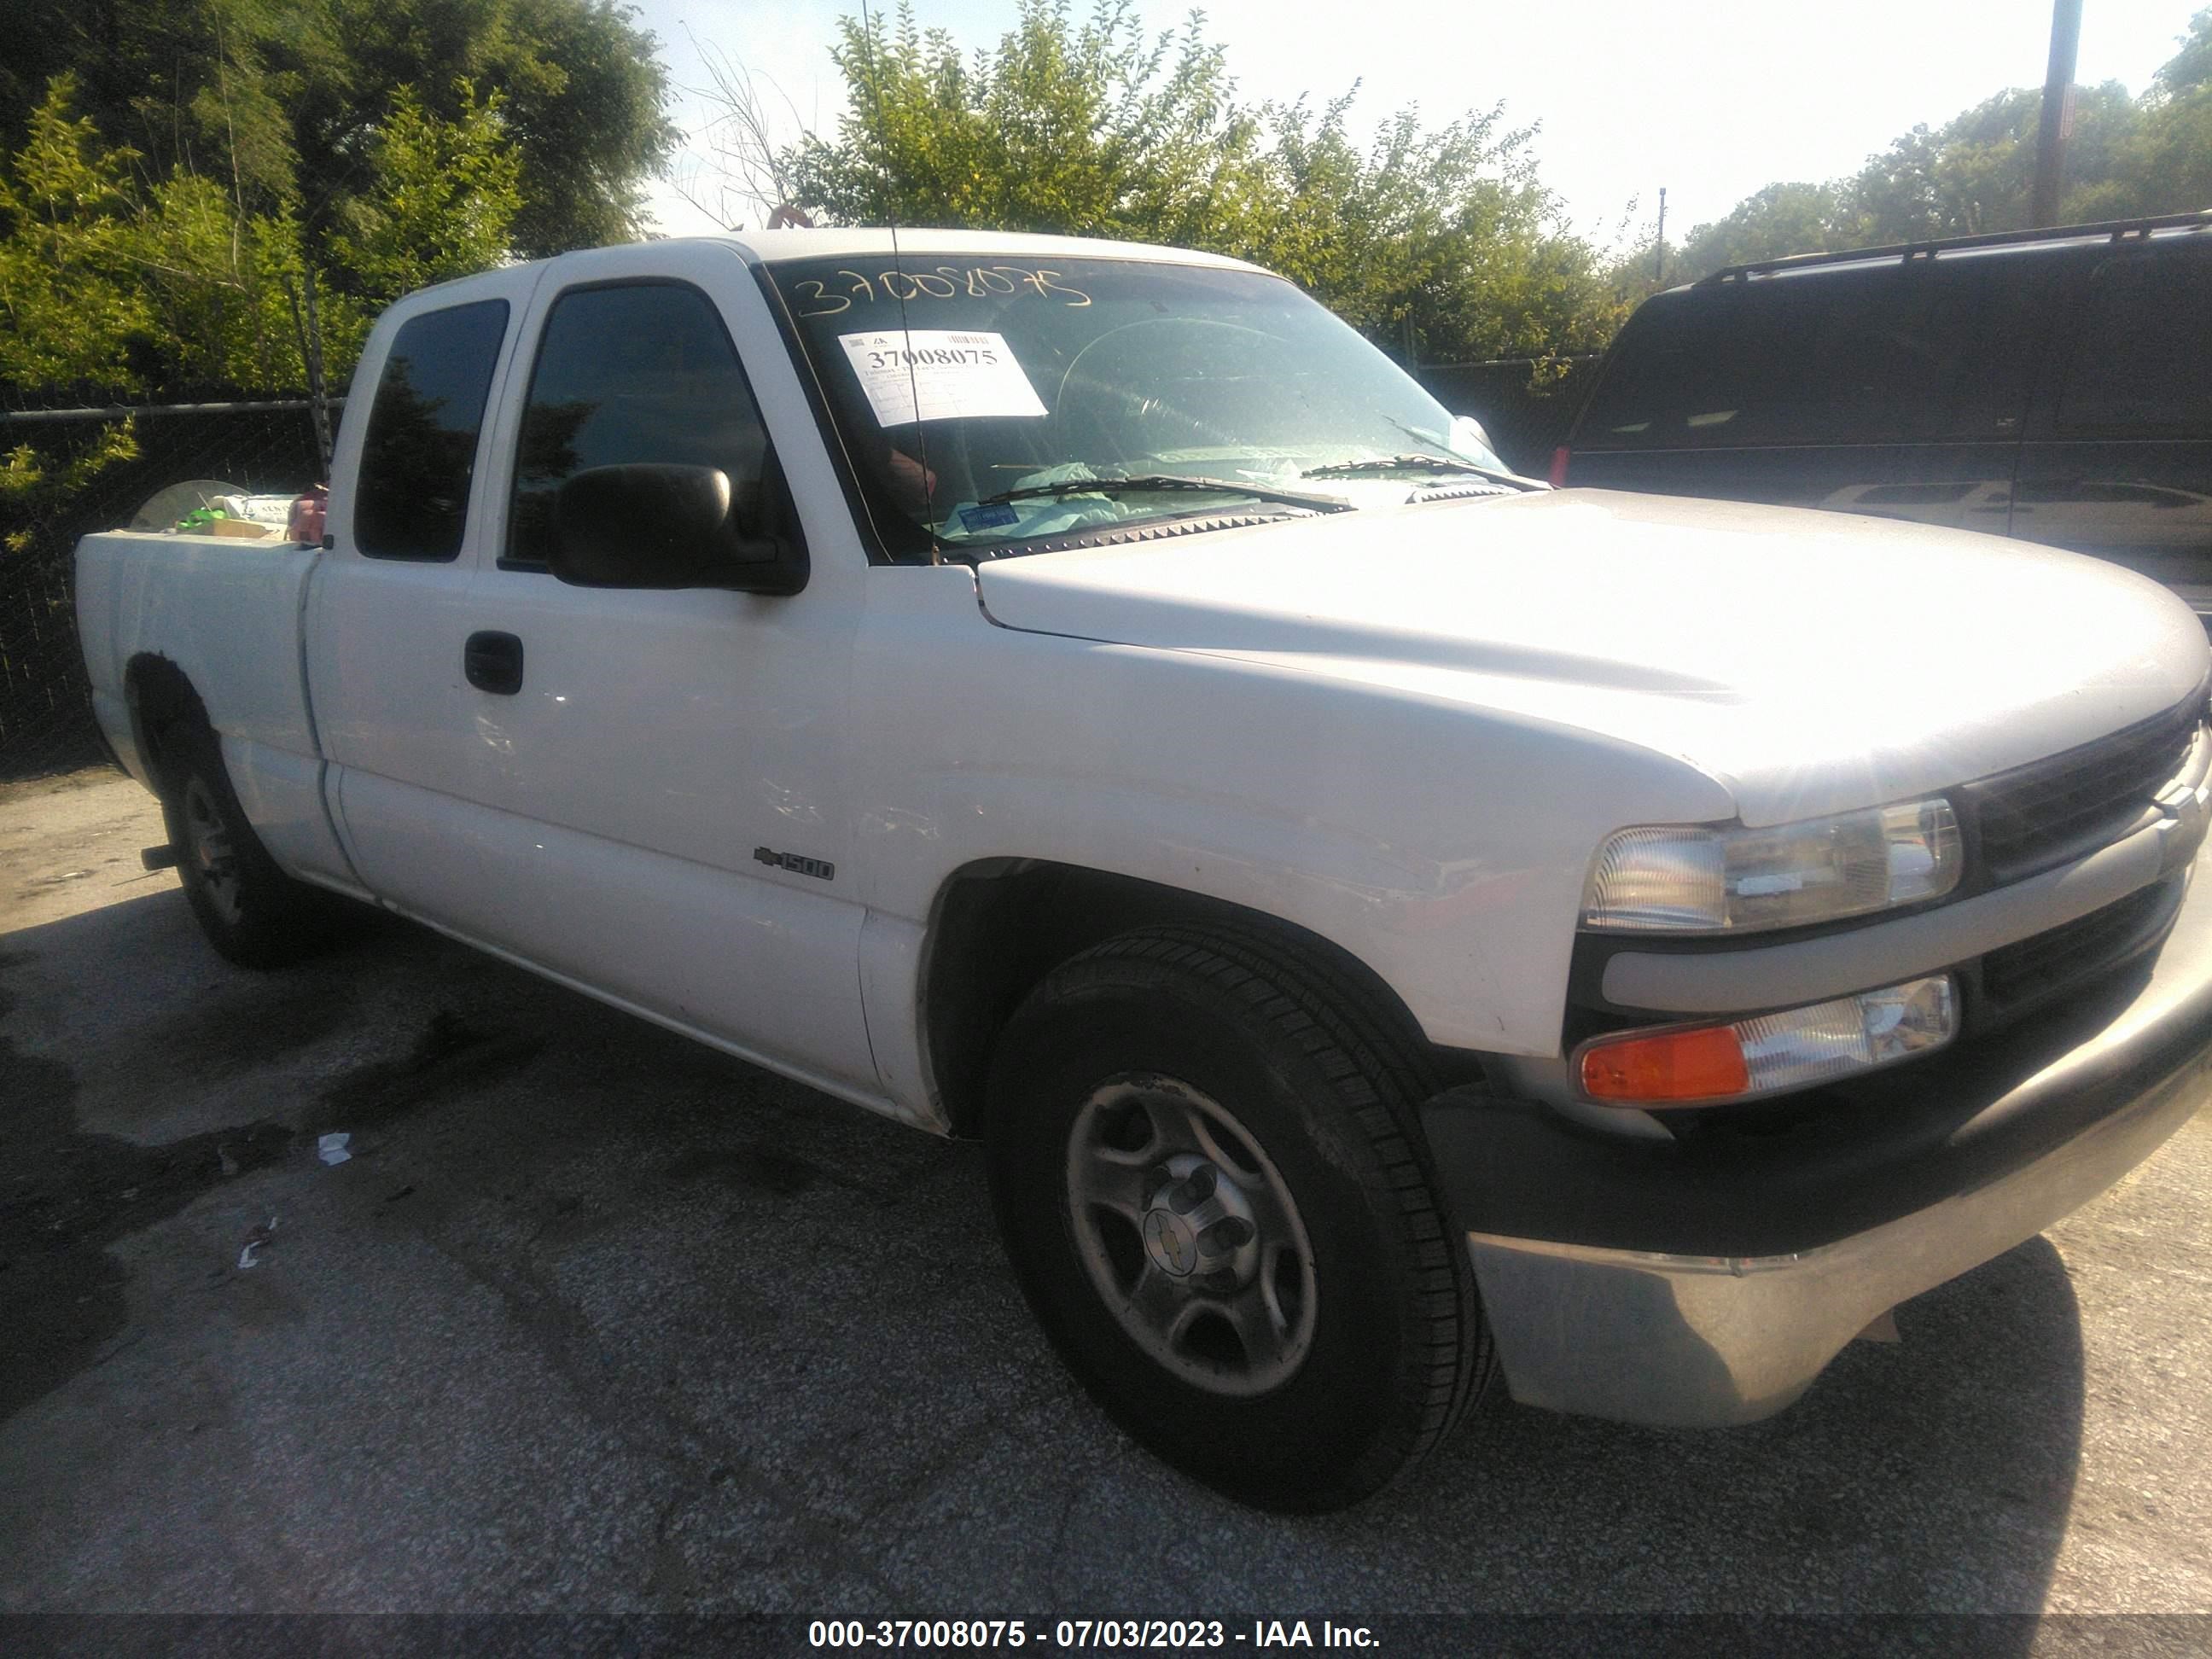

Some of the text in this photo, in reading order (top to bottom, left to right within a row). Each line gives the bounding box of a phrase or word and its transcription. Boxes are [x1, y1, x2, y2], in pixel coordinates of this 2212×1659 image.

[795, 266, 1092, 317] 37008075
[866, 348, 998, 370] 37008075
[780, 852, 835, 881] 1500
